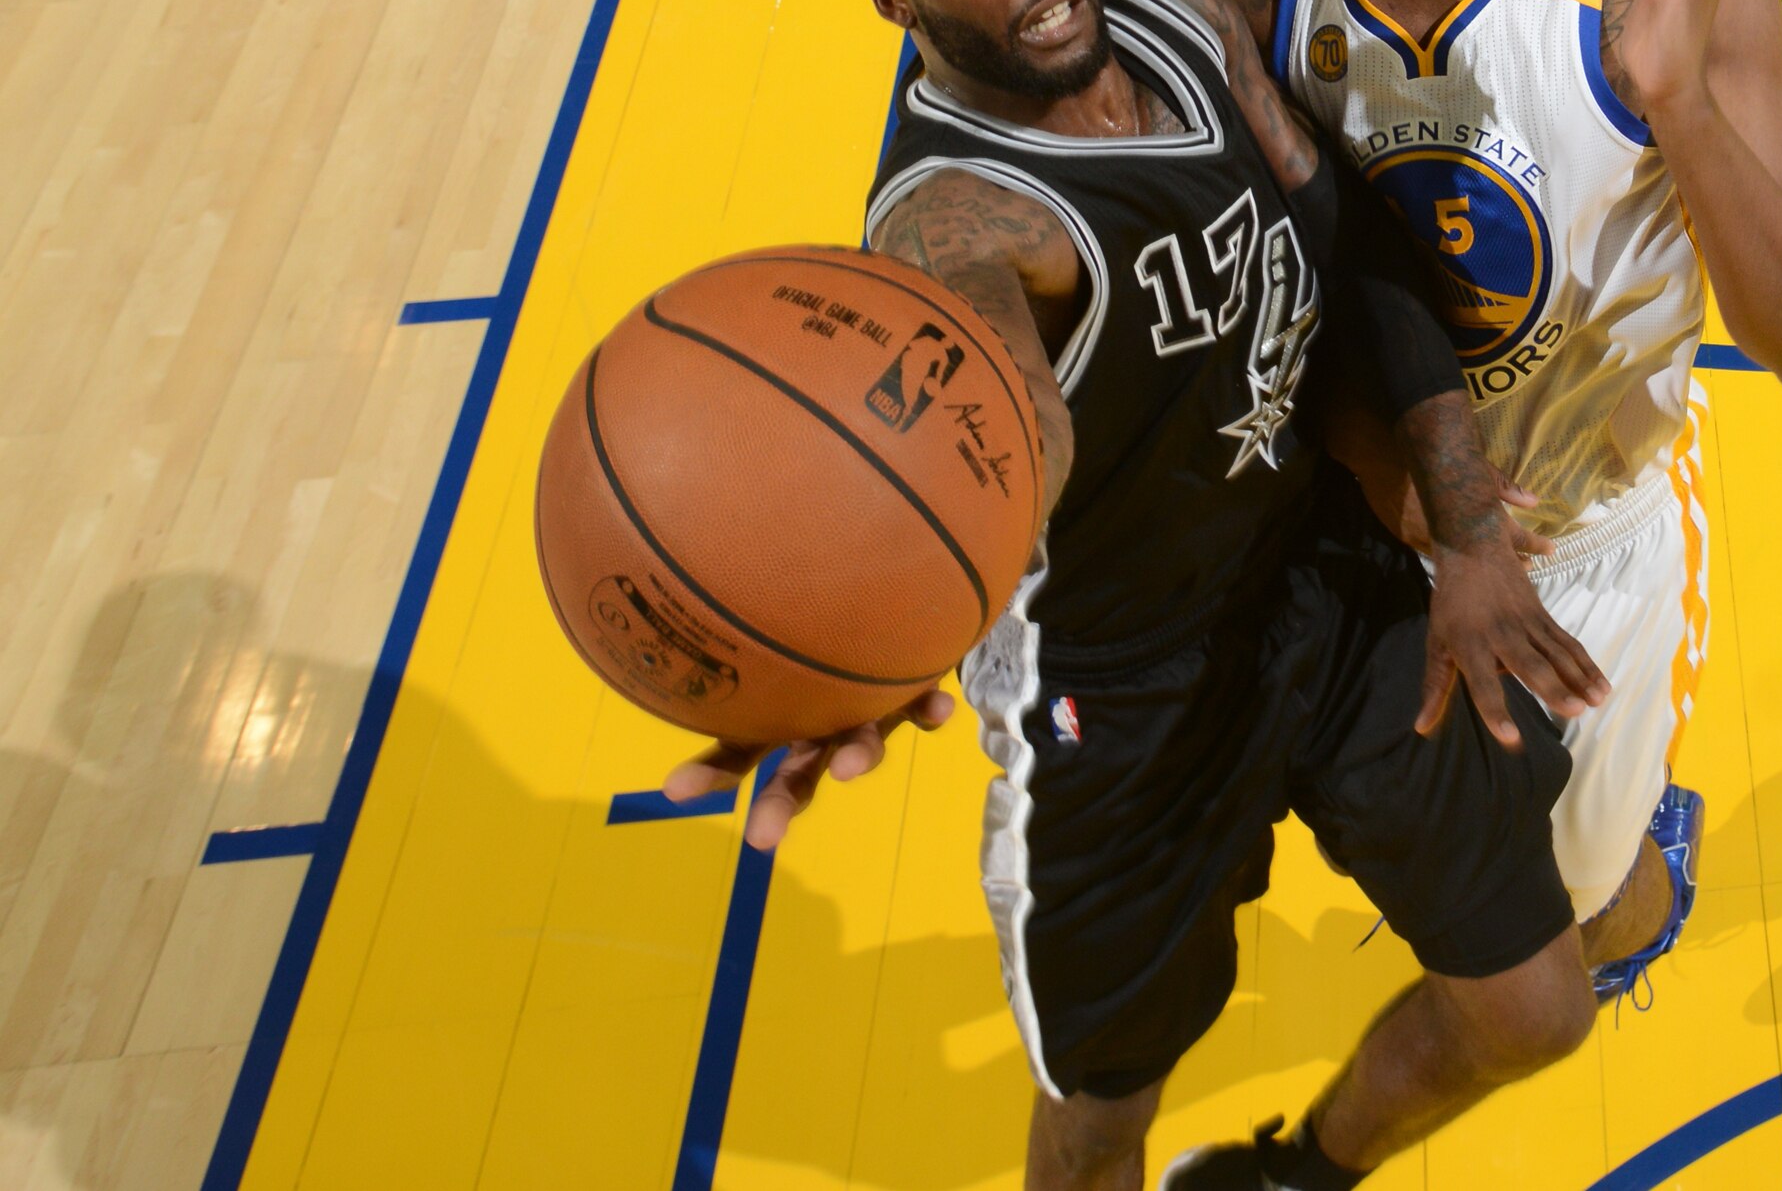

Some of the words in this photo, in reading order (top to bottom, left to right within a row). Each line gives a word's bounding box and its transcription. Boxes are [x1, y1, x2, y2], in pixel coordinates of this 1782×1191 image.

[1319, 39, 1340, 68] 70
[1352, 121, 1440, 164] LDEN
[1453, 123, 1547, 187] STATE
[1432, 195, 1475, 256] 5
[1133, 186, 1260, 358] 17
[772, 285, 826, 312] OFFICIAL
[825, 302, 864, 329] GAME
[860, 319, 893, 348] BALL
[1467, 320, 1564, 400] IORS
[869, 388, 901, 421] NBA
